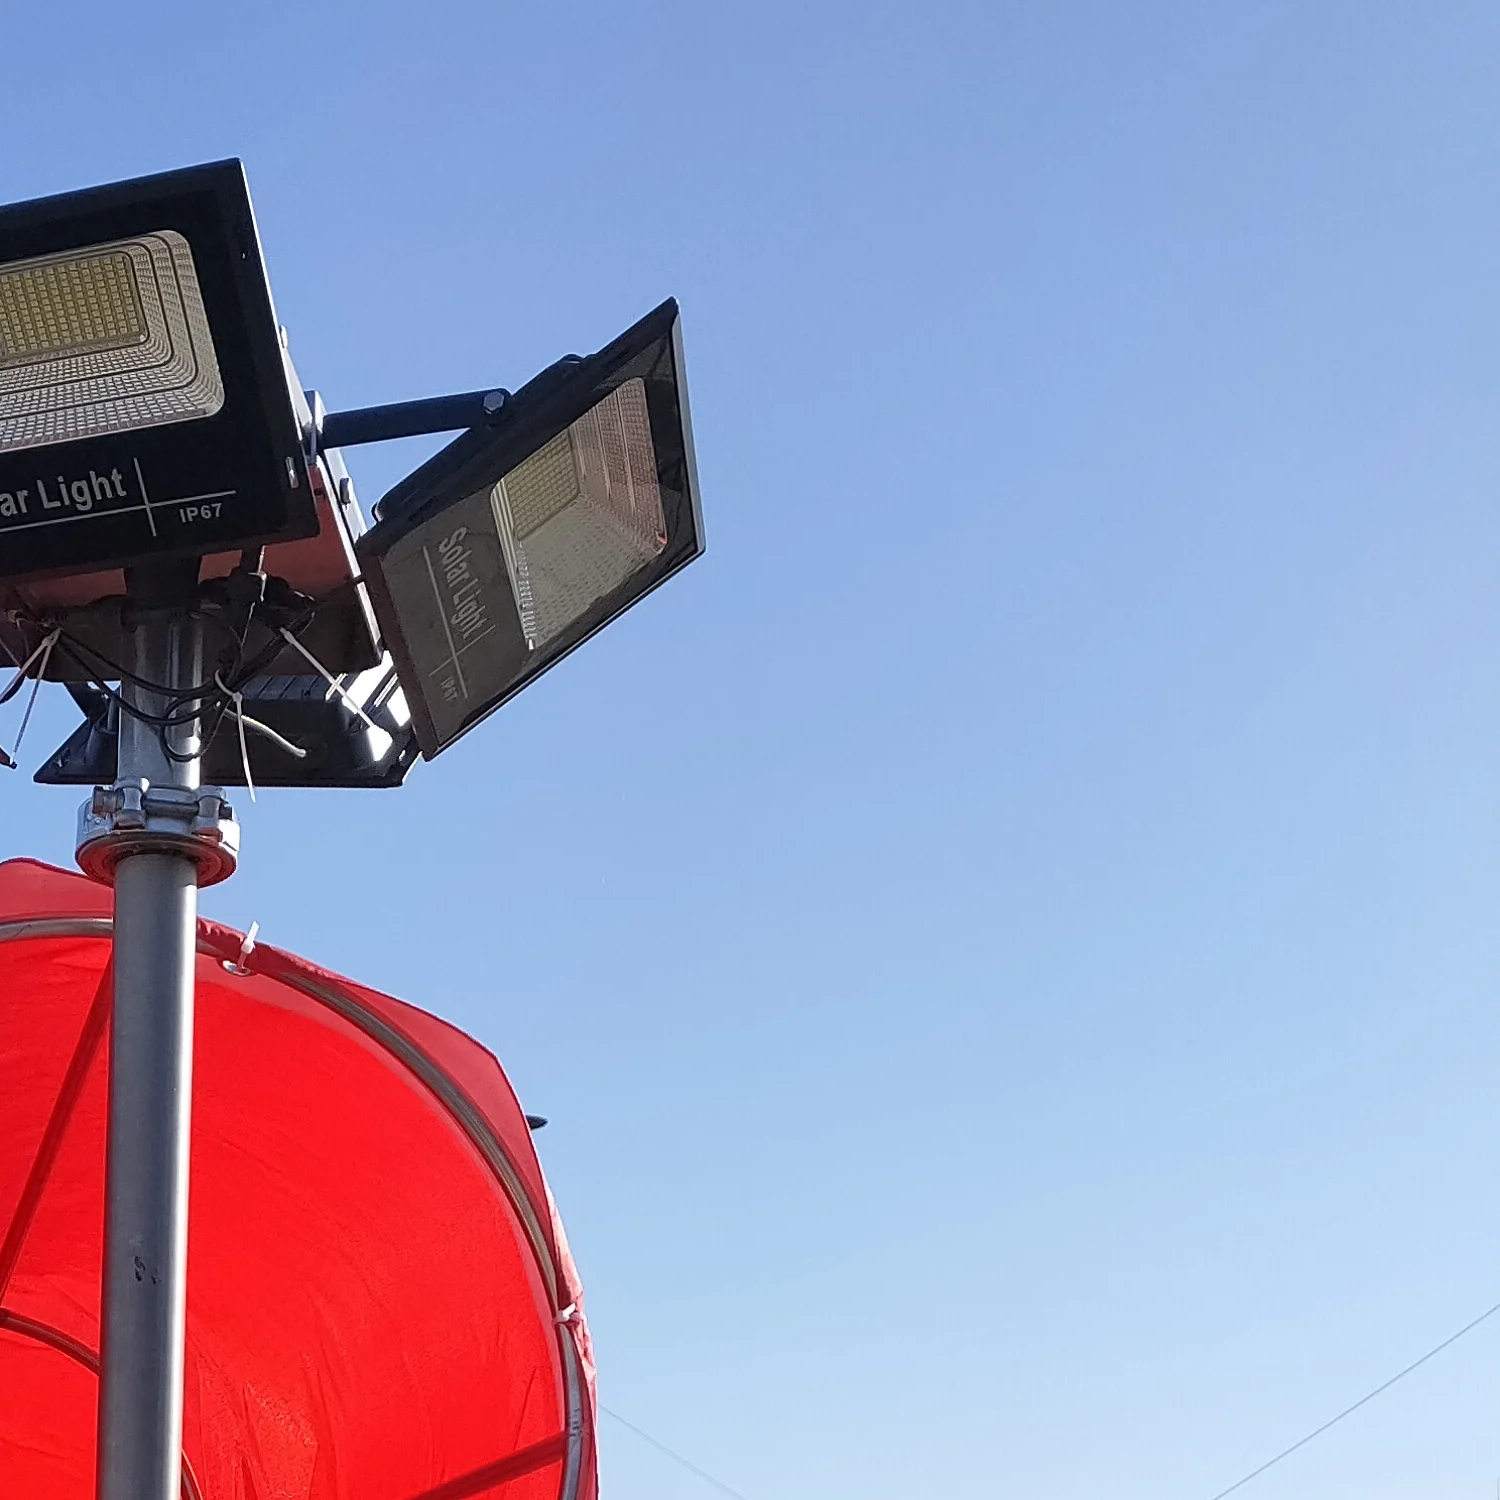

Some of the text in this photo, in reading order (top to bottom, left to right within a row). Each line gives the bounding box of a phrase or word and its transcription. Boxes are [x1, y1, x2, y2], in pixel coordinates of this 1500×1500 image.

[37, 467, 127, 511] Light
[179, 502, 223, 523] IP67
[438, 526, 487, 639] Solar Light
